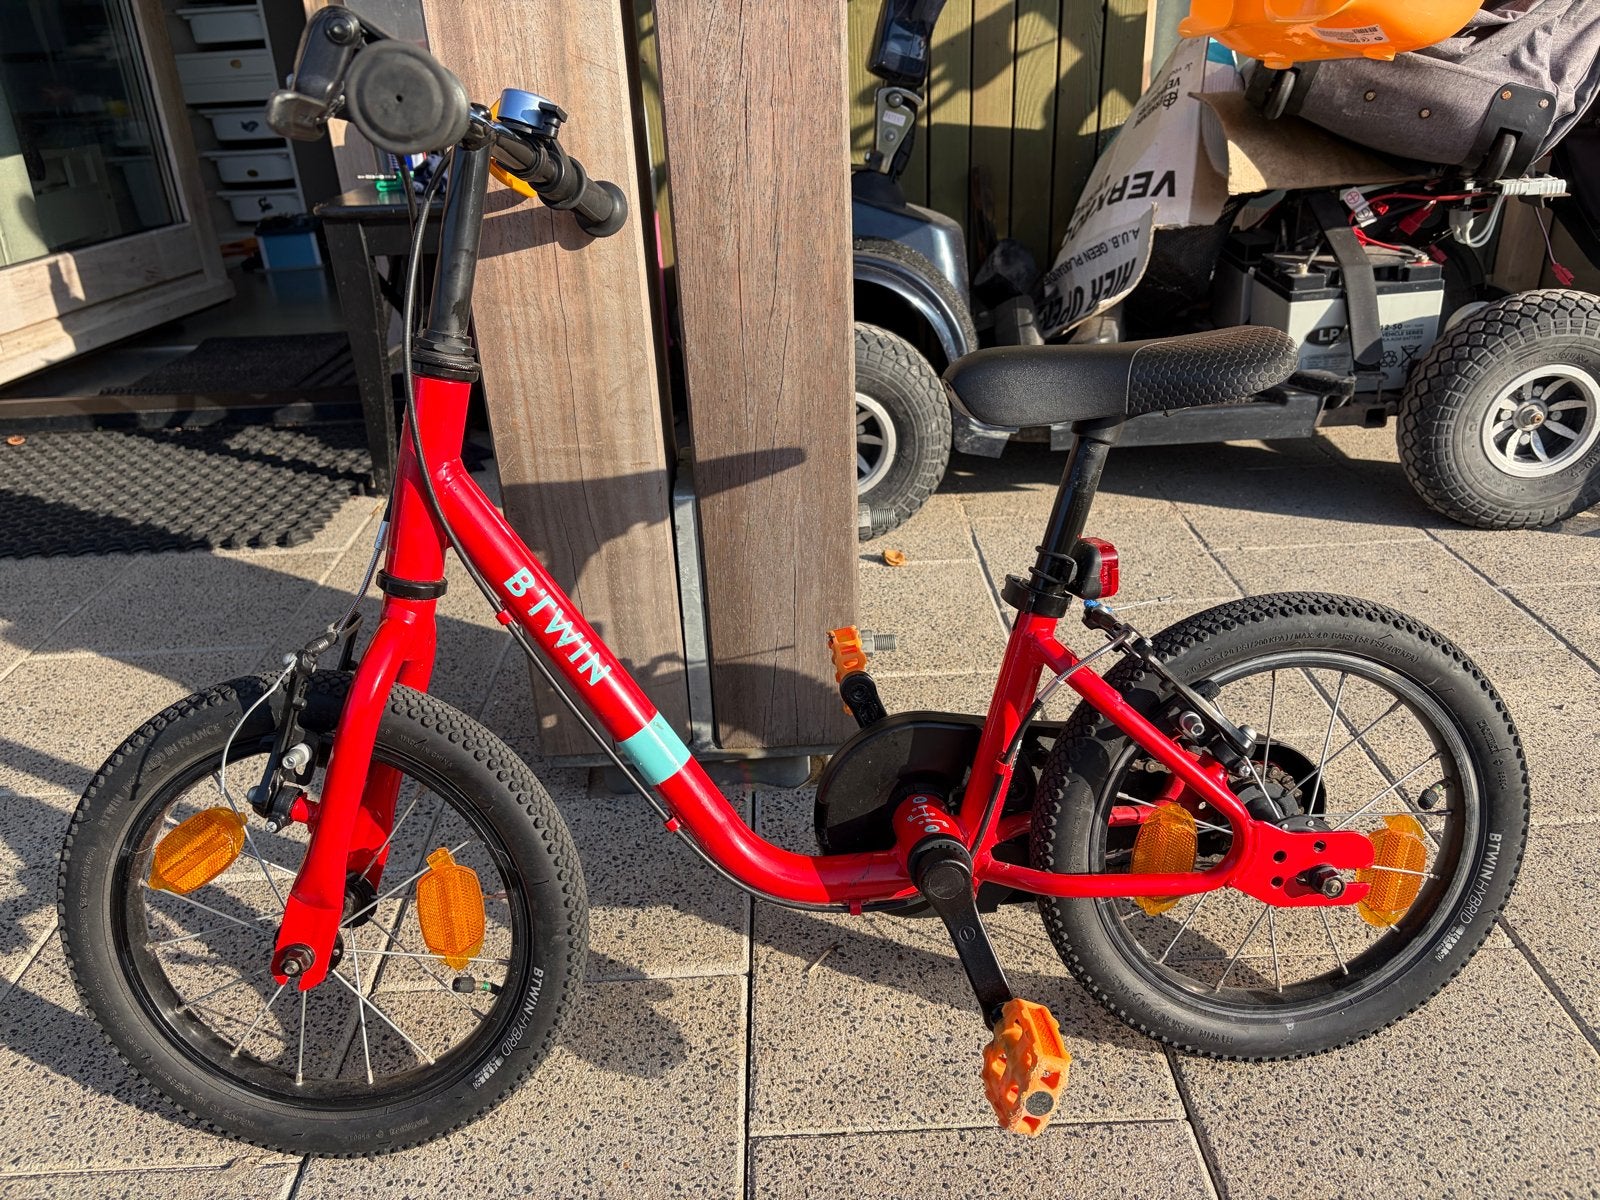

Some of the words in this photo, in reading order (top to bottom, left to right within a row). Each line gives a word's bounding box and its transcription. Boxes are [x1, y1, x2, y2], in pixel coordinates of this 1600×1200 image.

[1110, 227, 1140, 248] A.U.B.
[1083, 244, 1108, 262] GEEN
[1084, 257, 1136, 313] HIER
